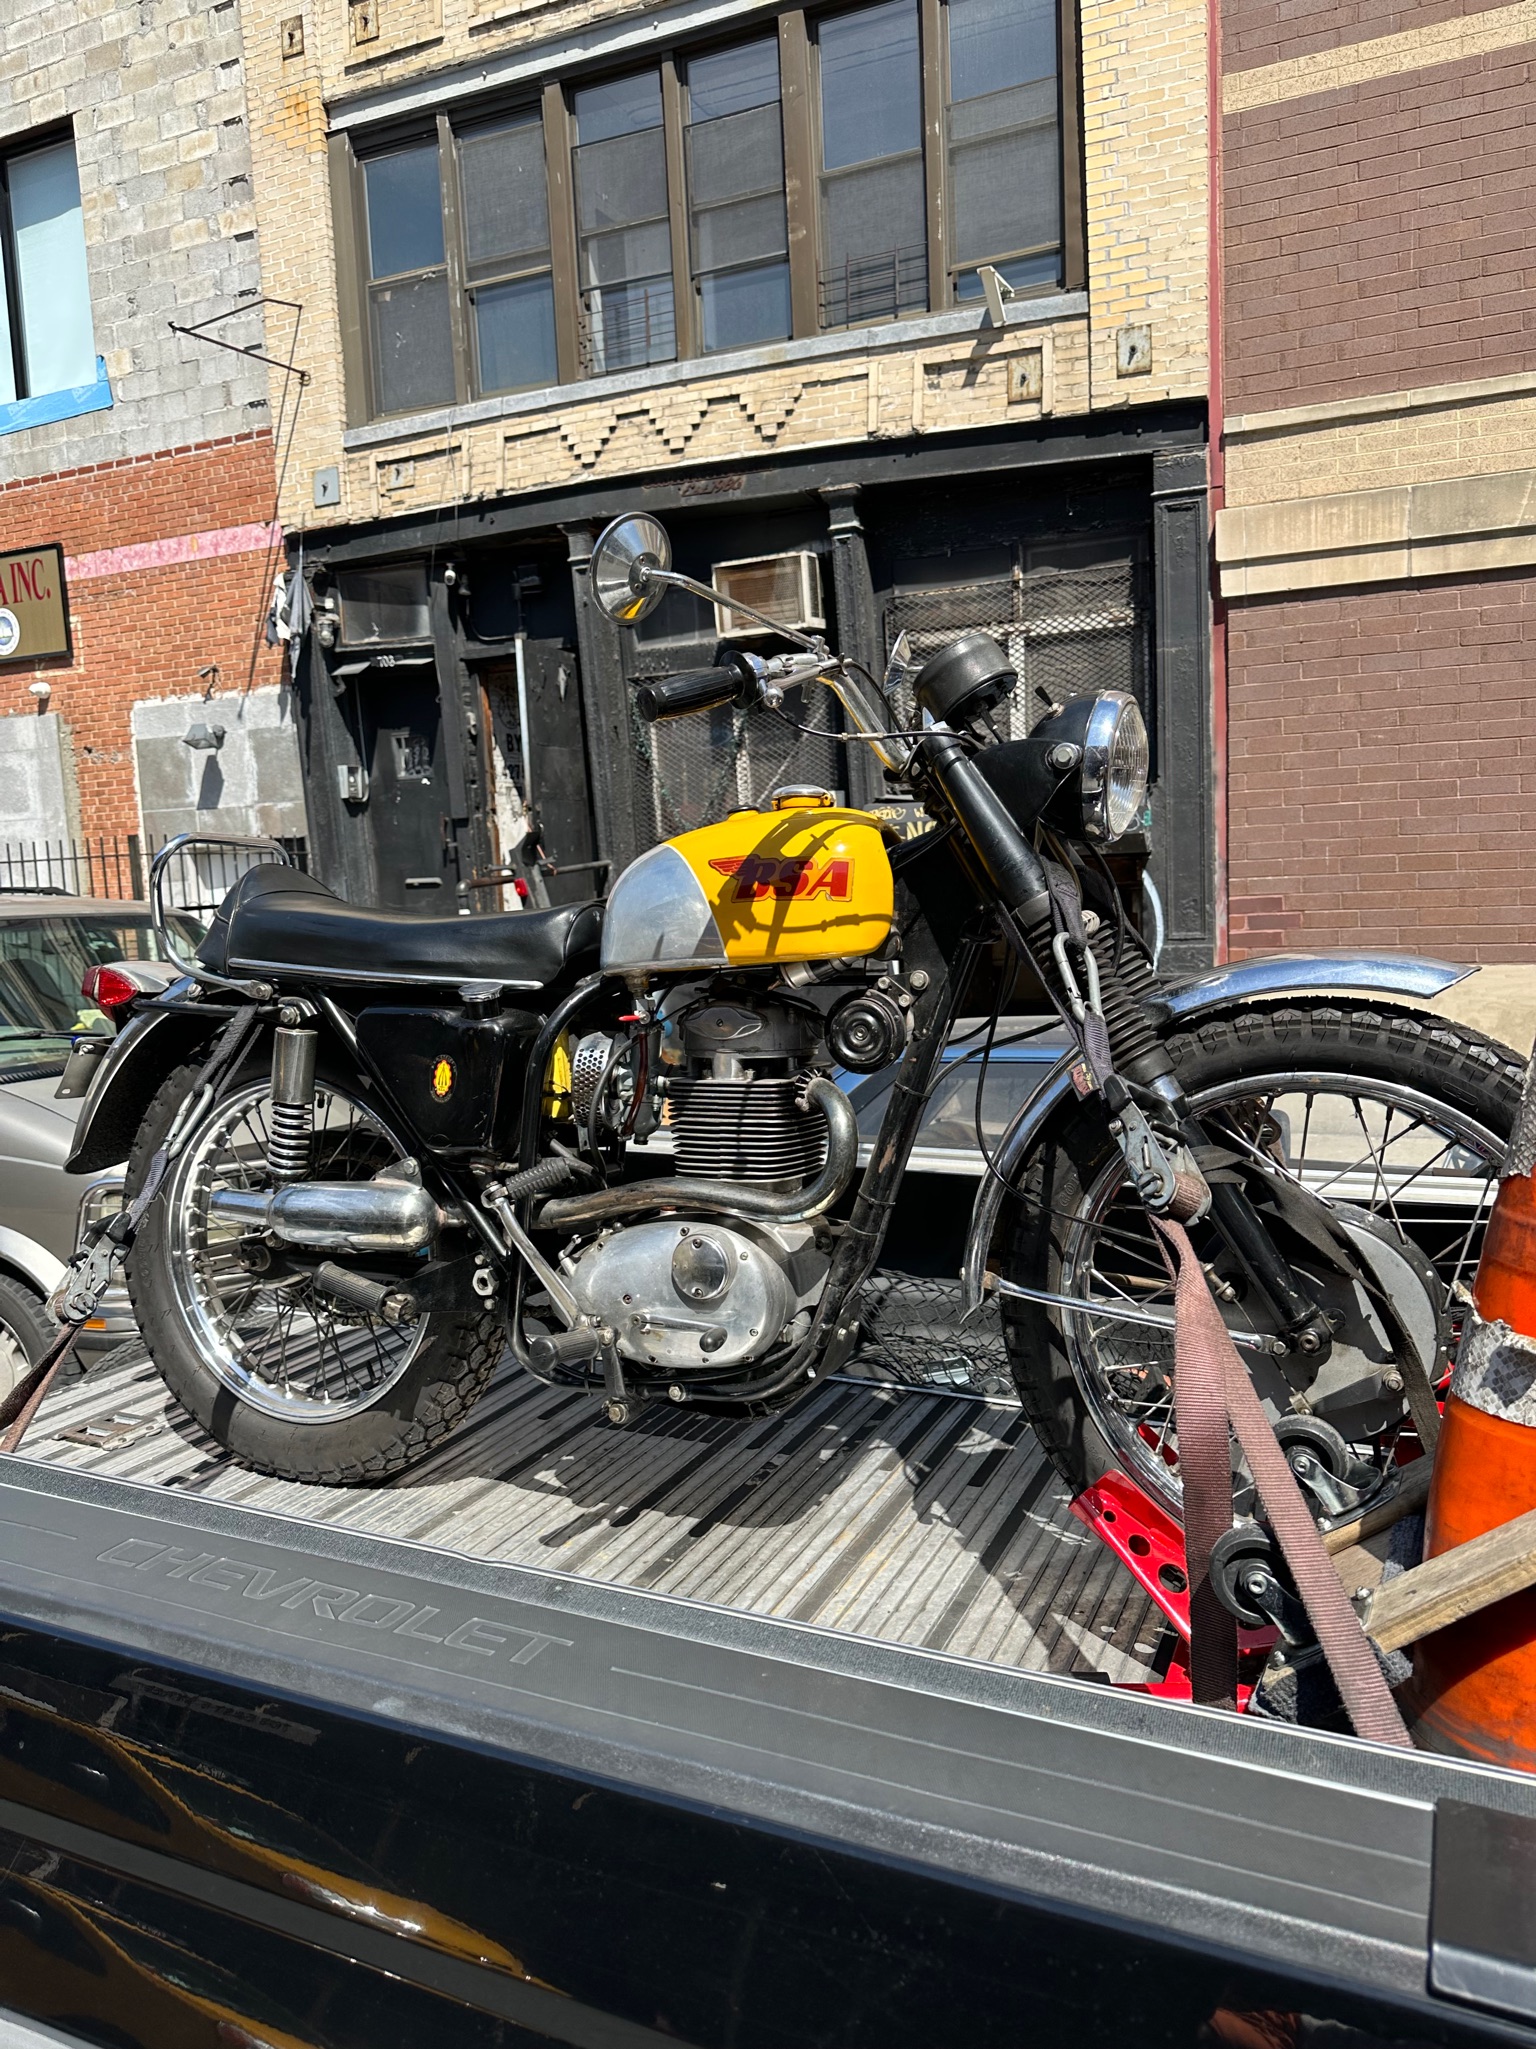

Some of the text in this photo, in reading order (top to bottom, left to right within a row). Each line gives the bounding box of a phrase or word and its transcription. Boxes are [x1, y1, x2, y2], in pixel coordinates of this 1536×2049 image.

[9, 558, 52, 604] INC.
[734, 858, 850, 899] BSA
[96, 1537, 574, 1666] CHEVROLET
